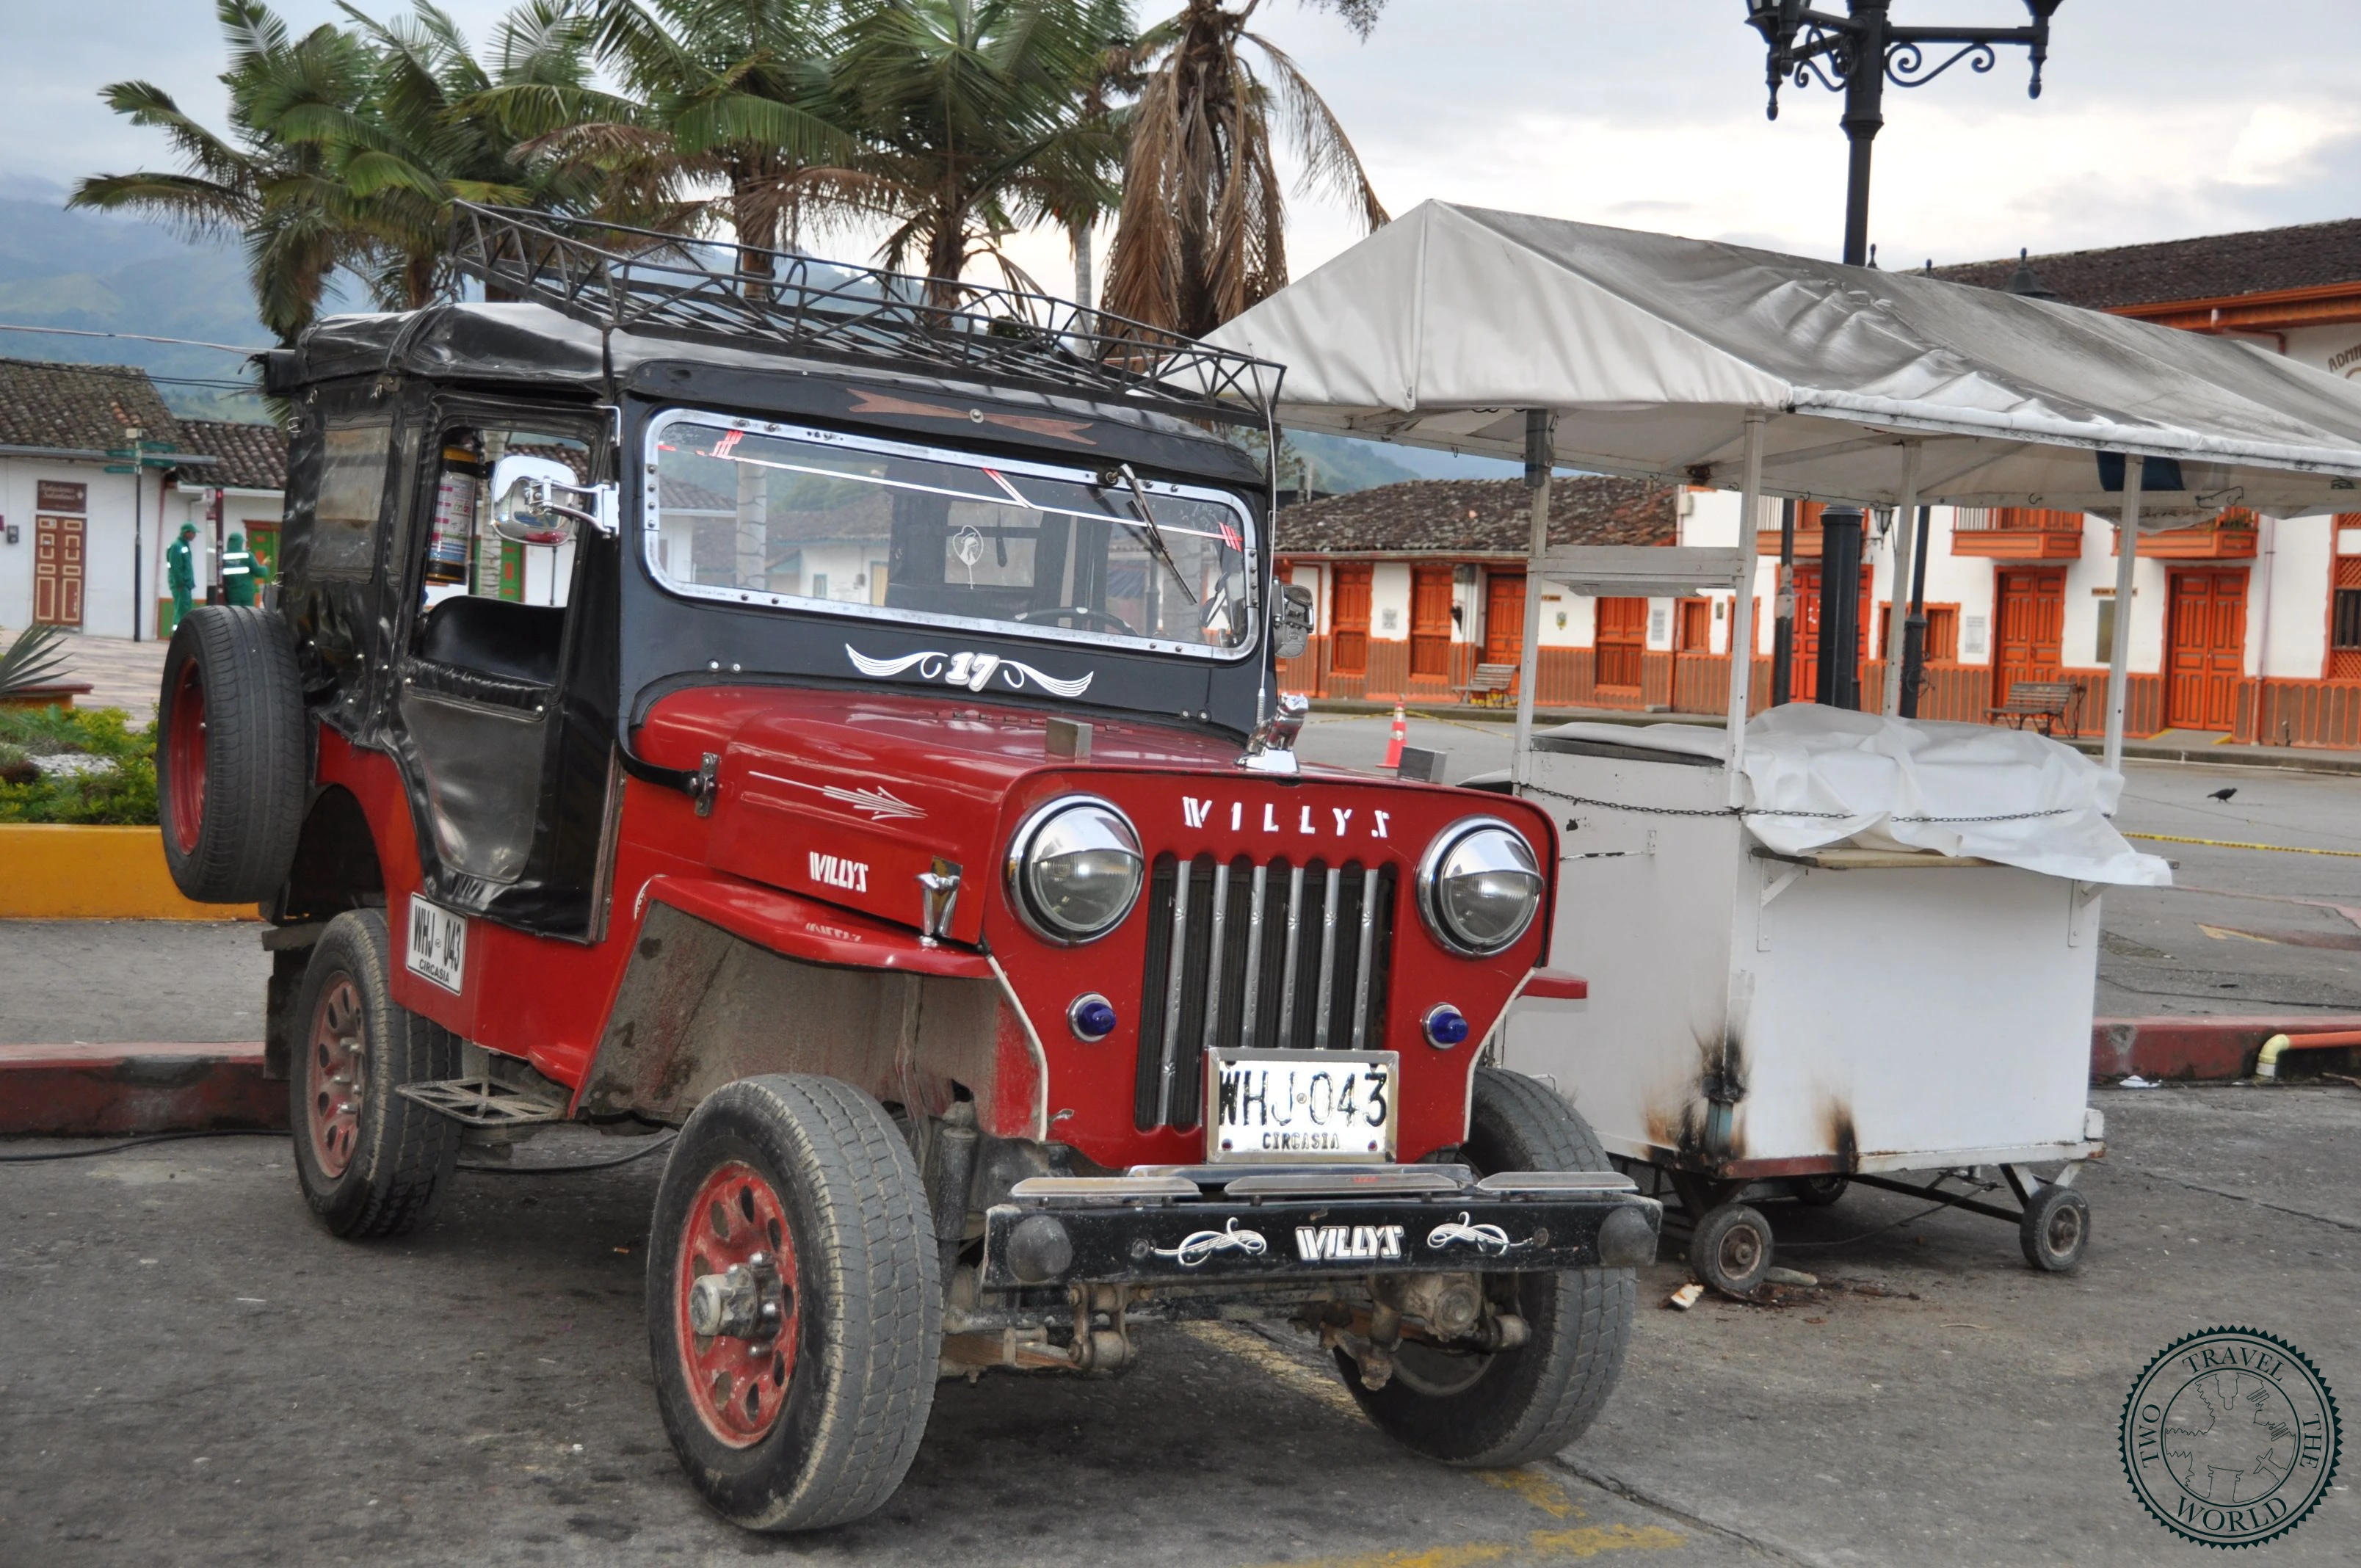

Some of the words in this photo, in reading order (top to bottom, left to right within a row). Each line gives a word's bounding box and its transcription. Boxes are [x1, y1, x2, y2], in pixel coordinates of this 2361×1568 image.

[946, 652, 1000, 692] 17
[1182, 796, 1390, 838] WILLYS
[810, 852, 868, 892] WILLYS
[413, 904, 435, 958] WHJ
[443, 919, 461, 972] 043
[419, 959, 450, 984] CIRCASIA
[1219, 1070, 1296, 1126] WHJ
[1309, 1071, 1388, 1127] 043
[1263, 1133, 1340, 1150] CIRCASIA
[1296, 1225, 1404, 1260] WILLYS
